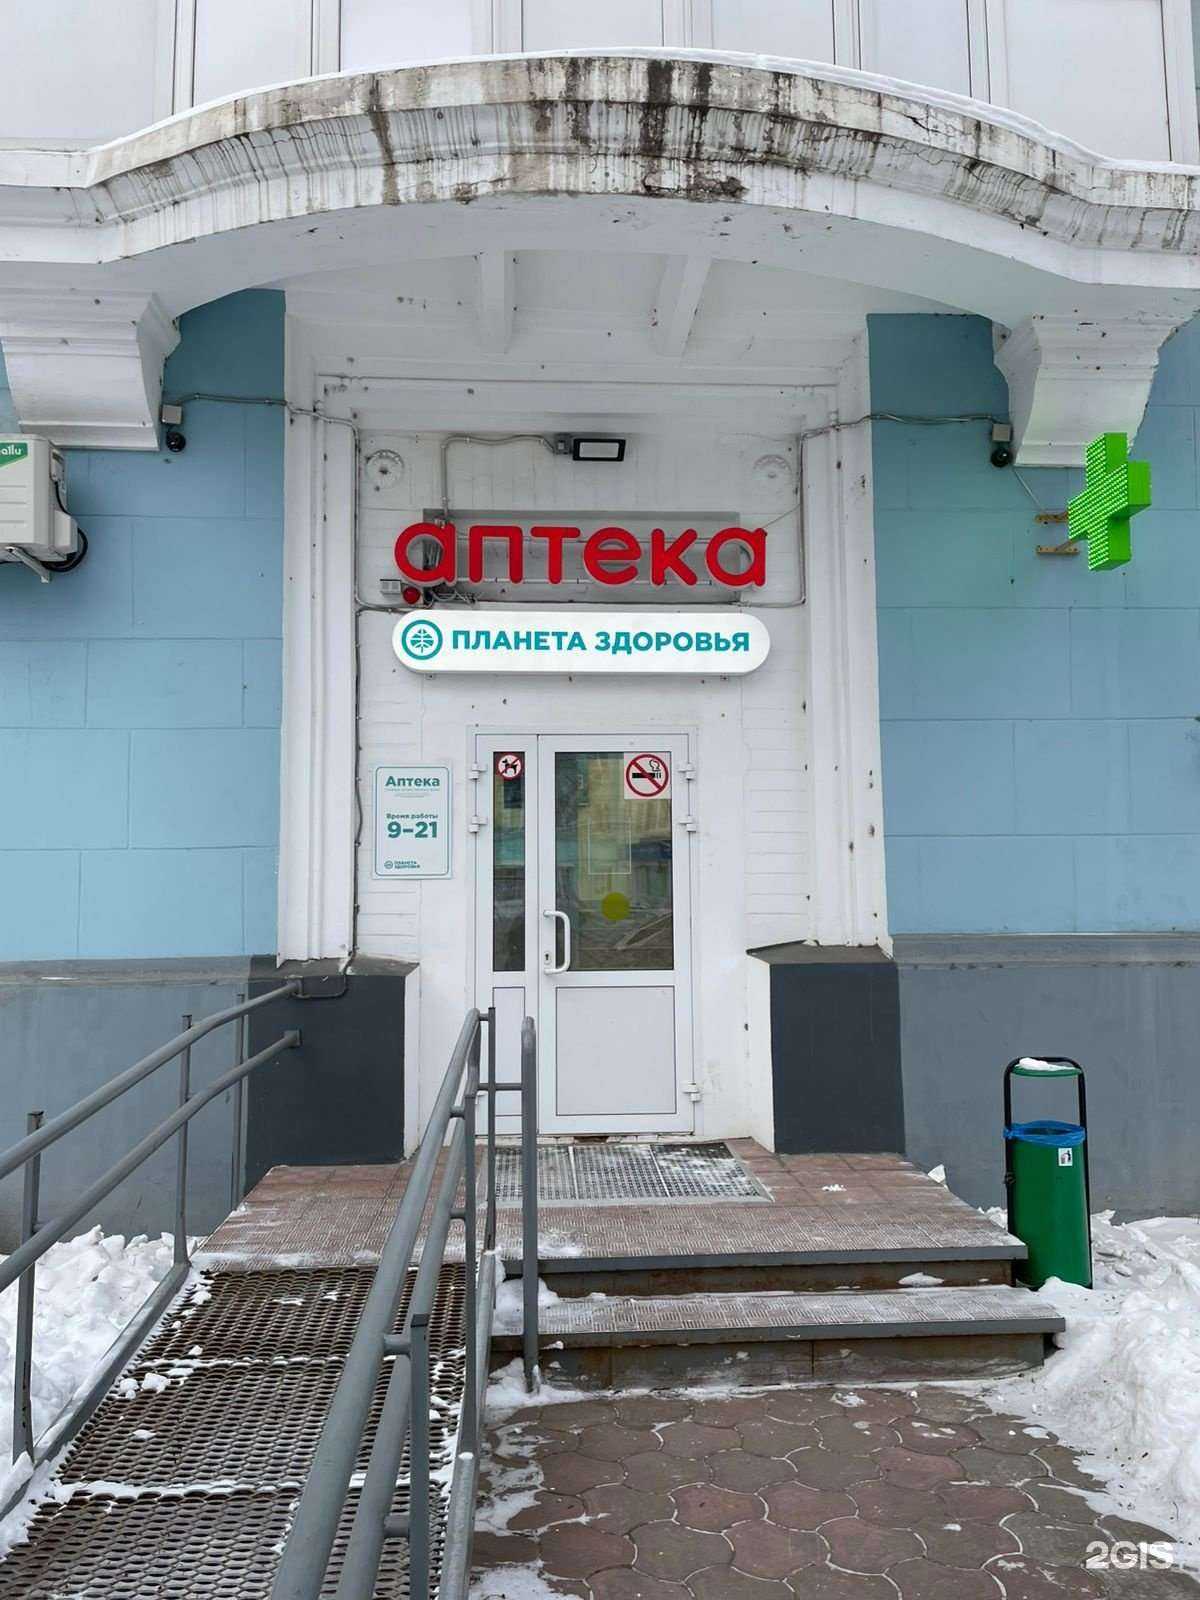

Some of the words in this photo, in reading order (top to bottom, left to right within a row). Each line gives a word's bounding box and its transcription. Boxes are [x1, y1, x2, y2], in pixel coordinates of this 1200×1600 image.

[0, 444, 22, 455] allu
[394, 522, 768, 588] аптека
[453, 630, 587, 651] ПЛАНЕТА
[595, 631, 750, 655] ЗДОРОВЬЯ
[385, 776, 440, 787] Аптека
